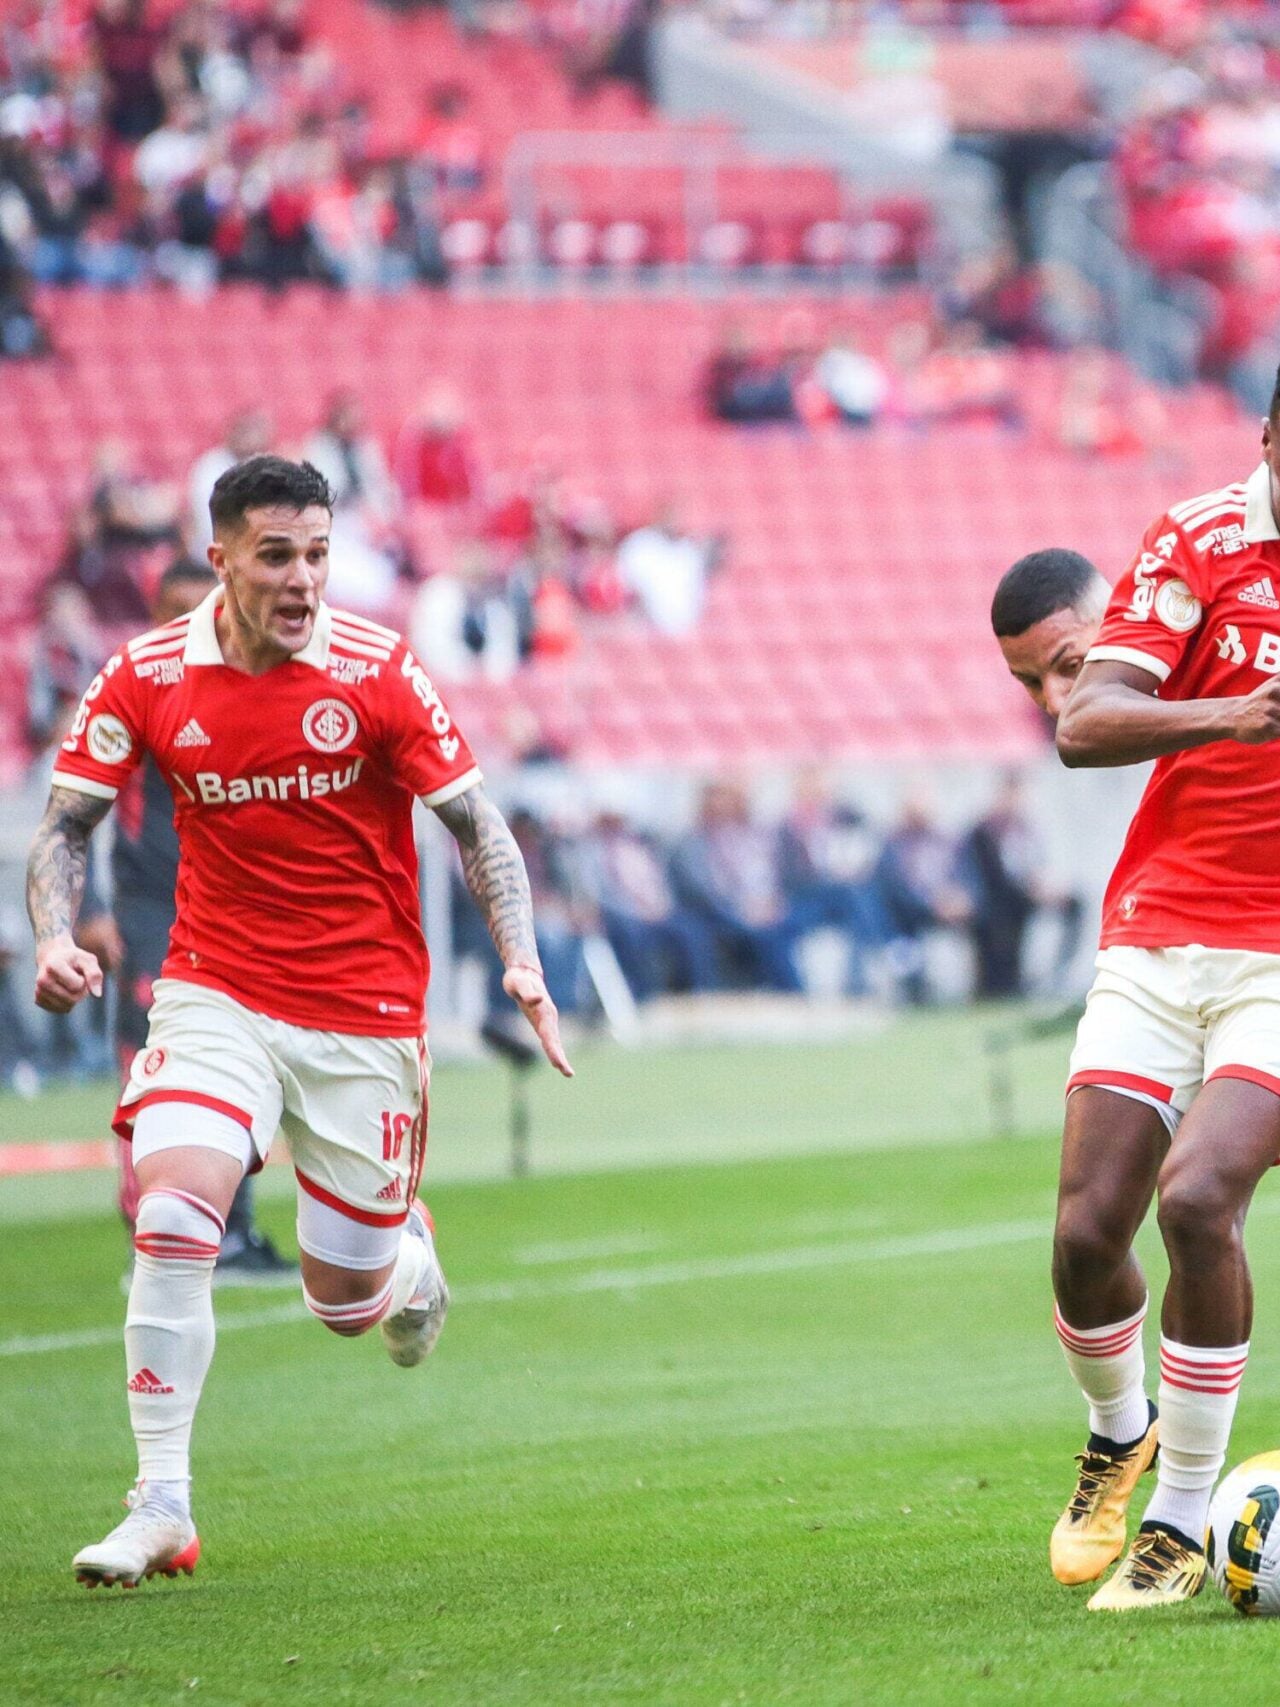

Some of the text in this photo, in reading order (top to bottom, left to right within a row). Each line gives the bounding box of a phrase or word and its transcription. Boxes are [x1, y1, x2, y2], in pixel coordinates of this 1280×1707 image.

[1238, 592, 1280, 610] adidas
[401, 650, 451, 735] vero
[174, 735, 212, 747] adidas
[196, 757, 365, 804] Banrisul
